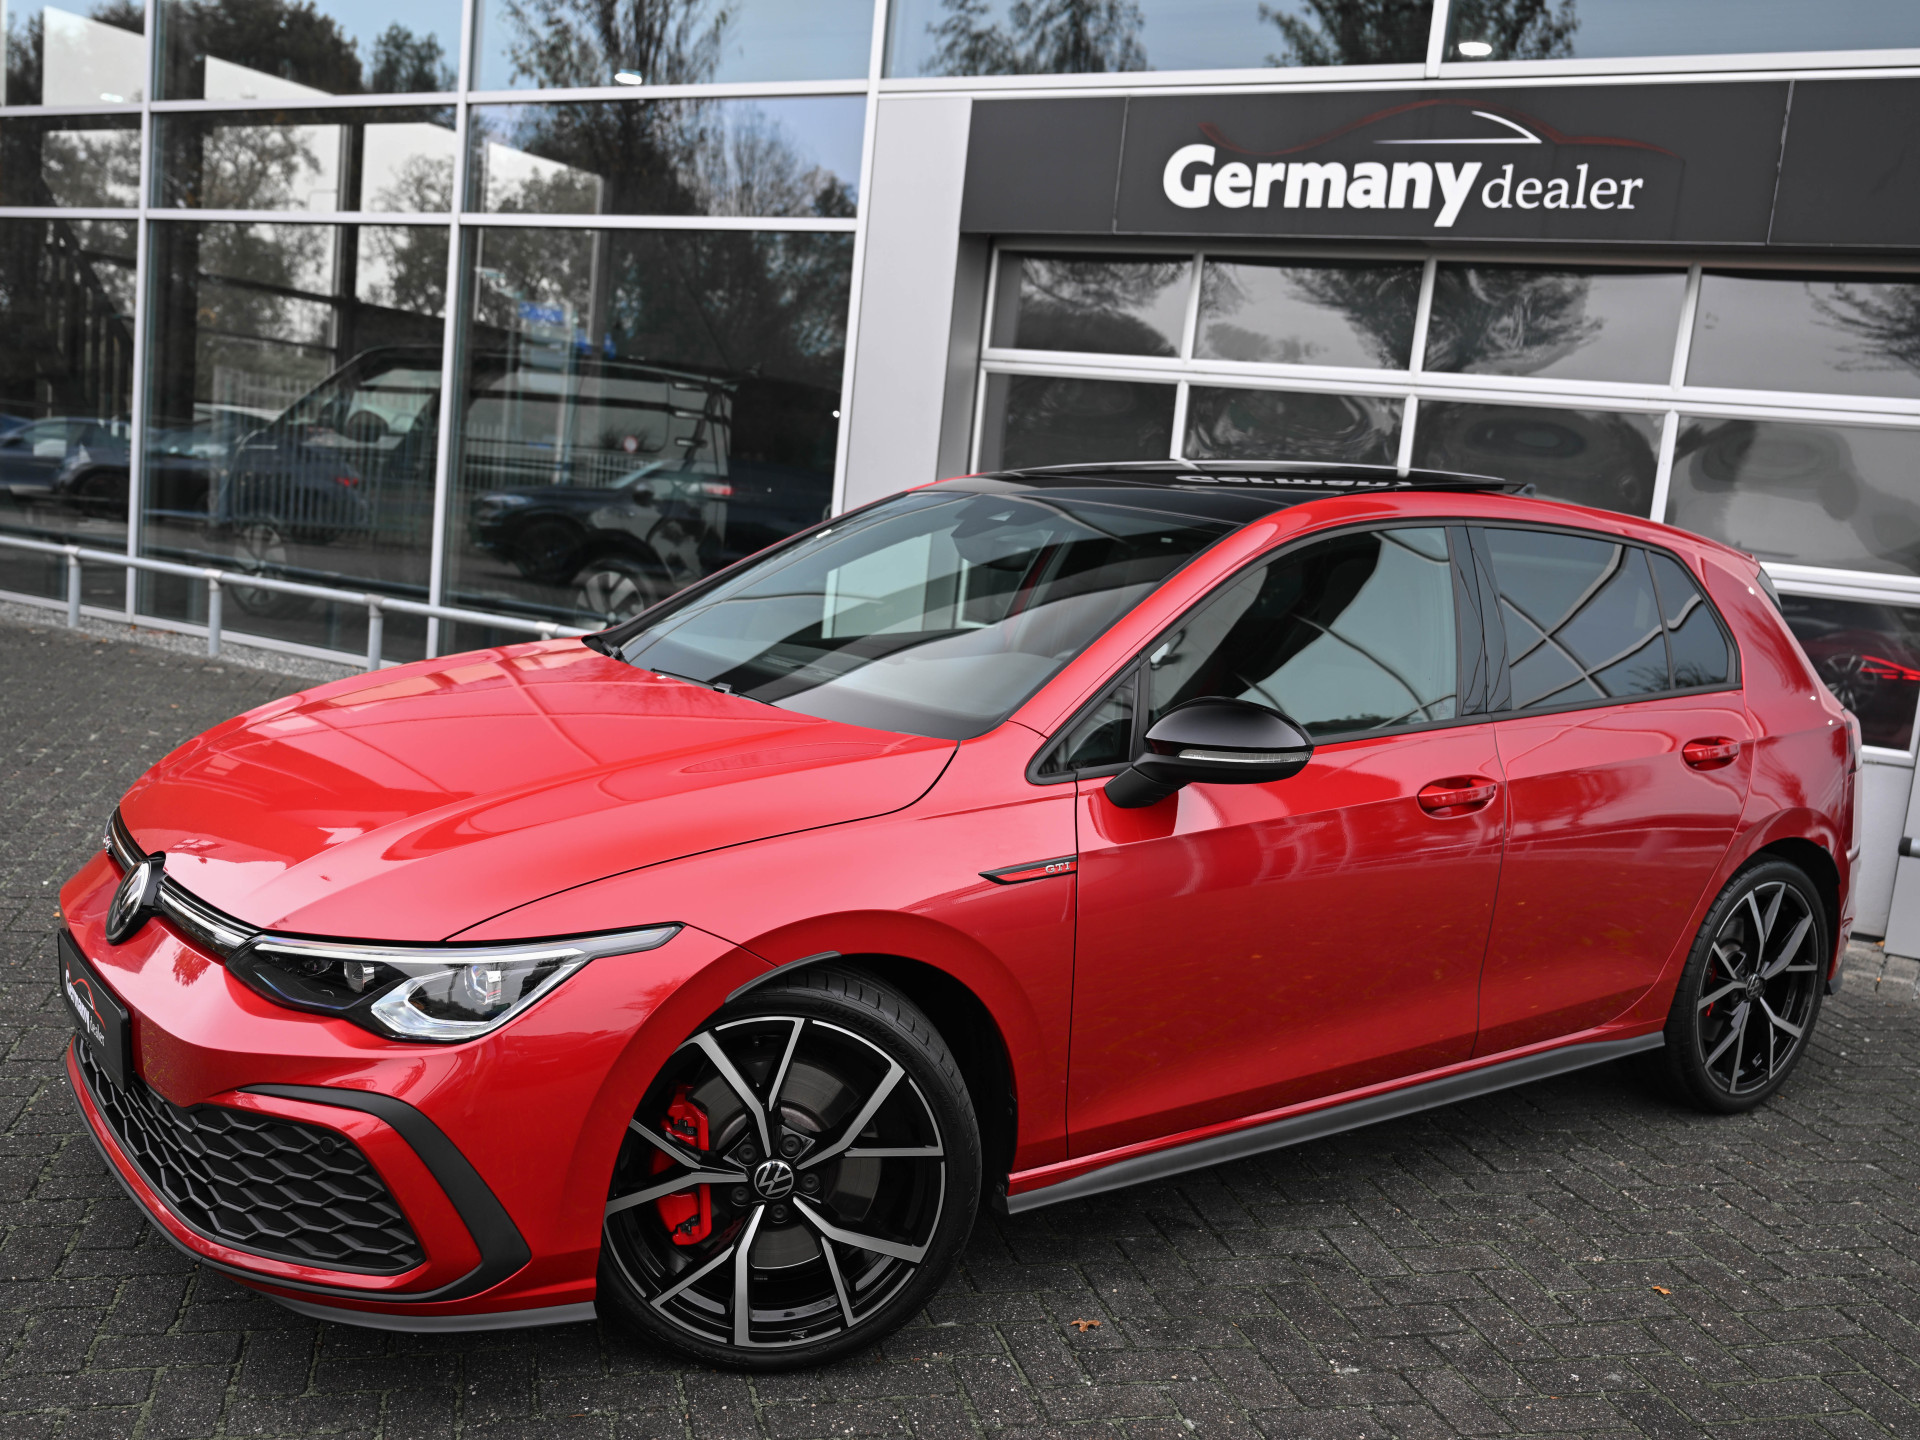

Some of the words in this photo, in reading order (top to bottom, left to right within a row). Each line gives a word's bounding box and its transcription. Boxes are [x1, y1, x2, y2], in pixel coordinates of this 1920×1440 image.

[1163, 143, 1482, 227] Germany
[1481, 163, 1644, 210] dealer
[1045, 861, 1071, 874] GTI
